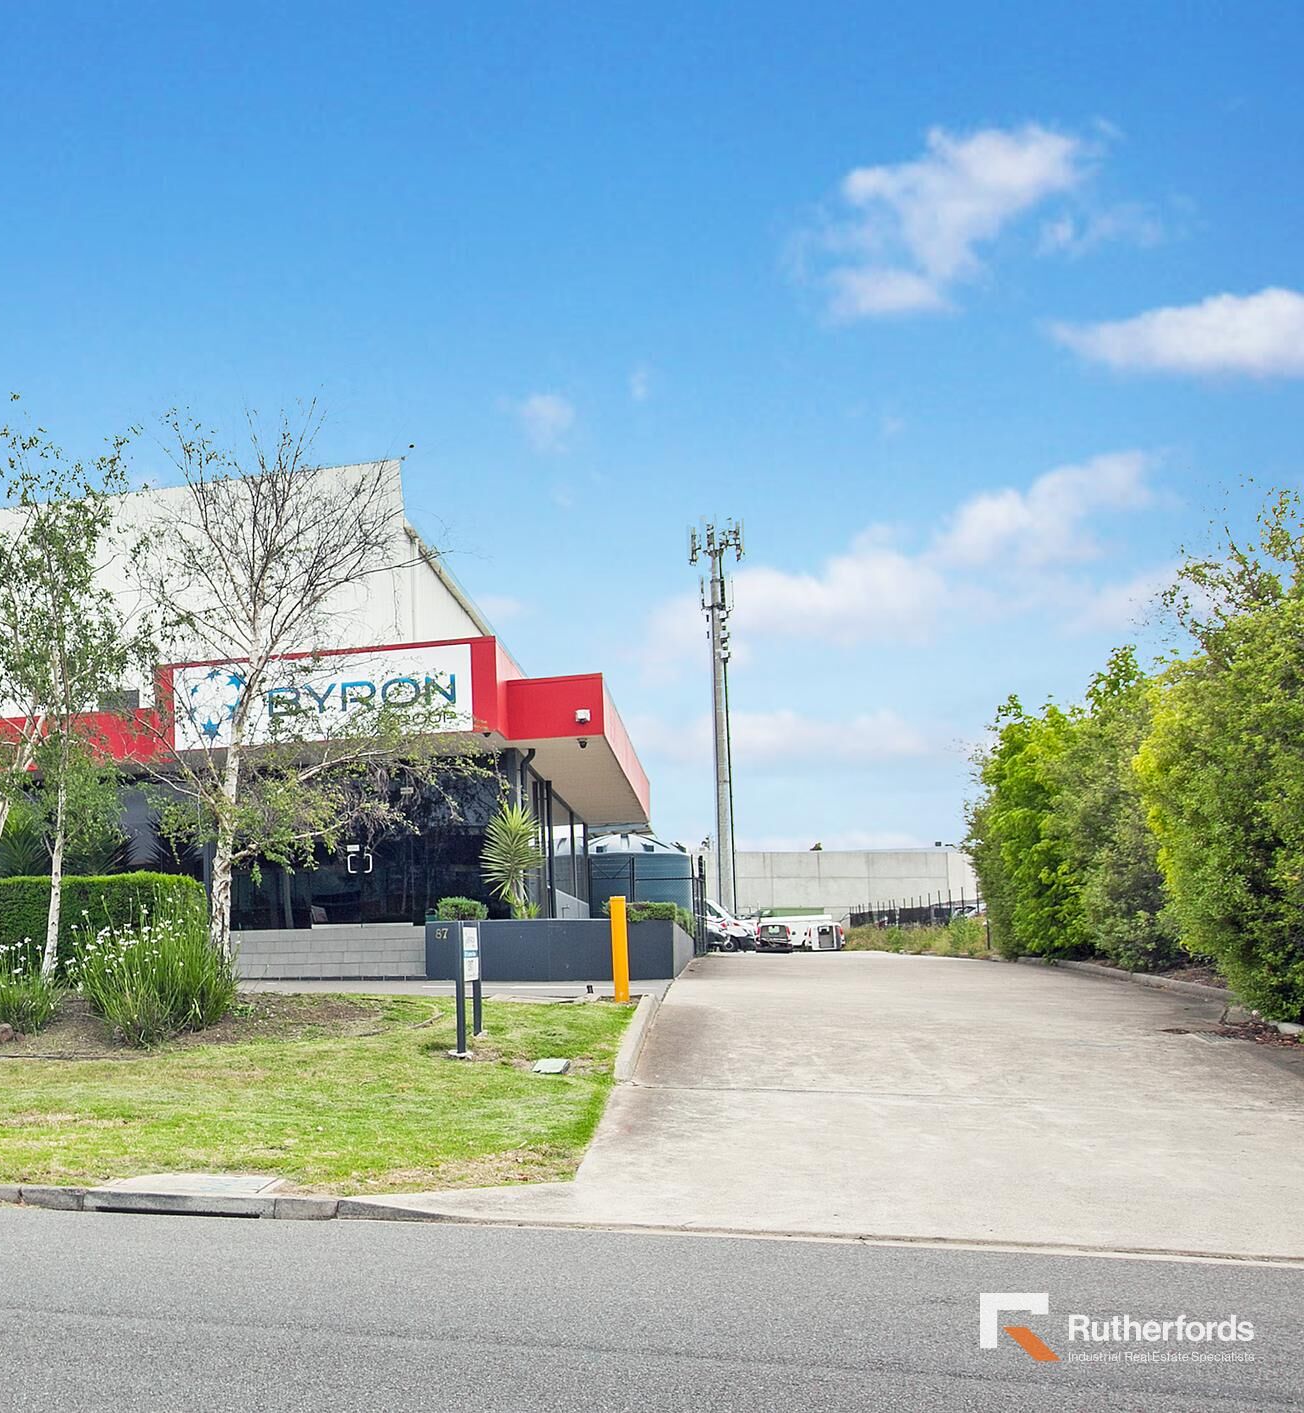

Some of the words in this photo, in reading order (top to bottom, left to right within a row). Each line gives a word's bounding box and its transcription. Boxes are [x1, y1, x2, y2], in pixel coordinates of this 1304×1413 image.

[267, 674, 457, 718] BYRON
[386, 710, 458, 726] ROUP
[435, 928, 449, 940] 87
